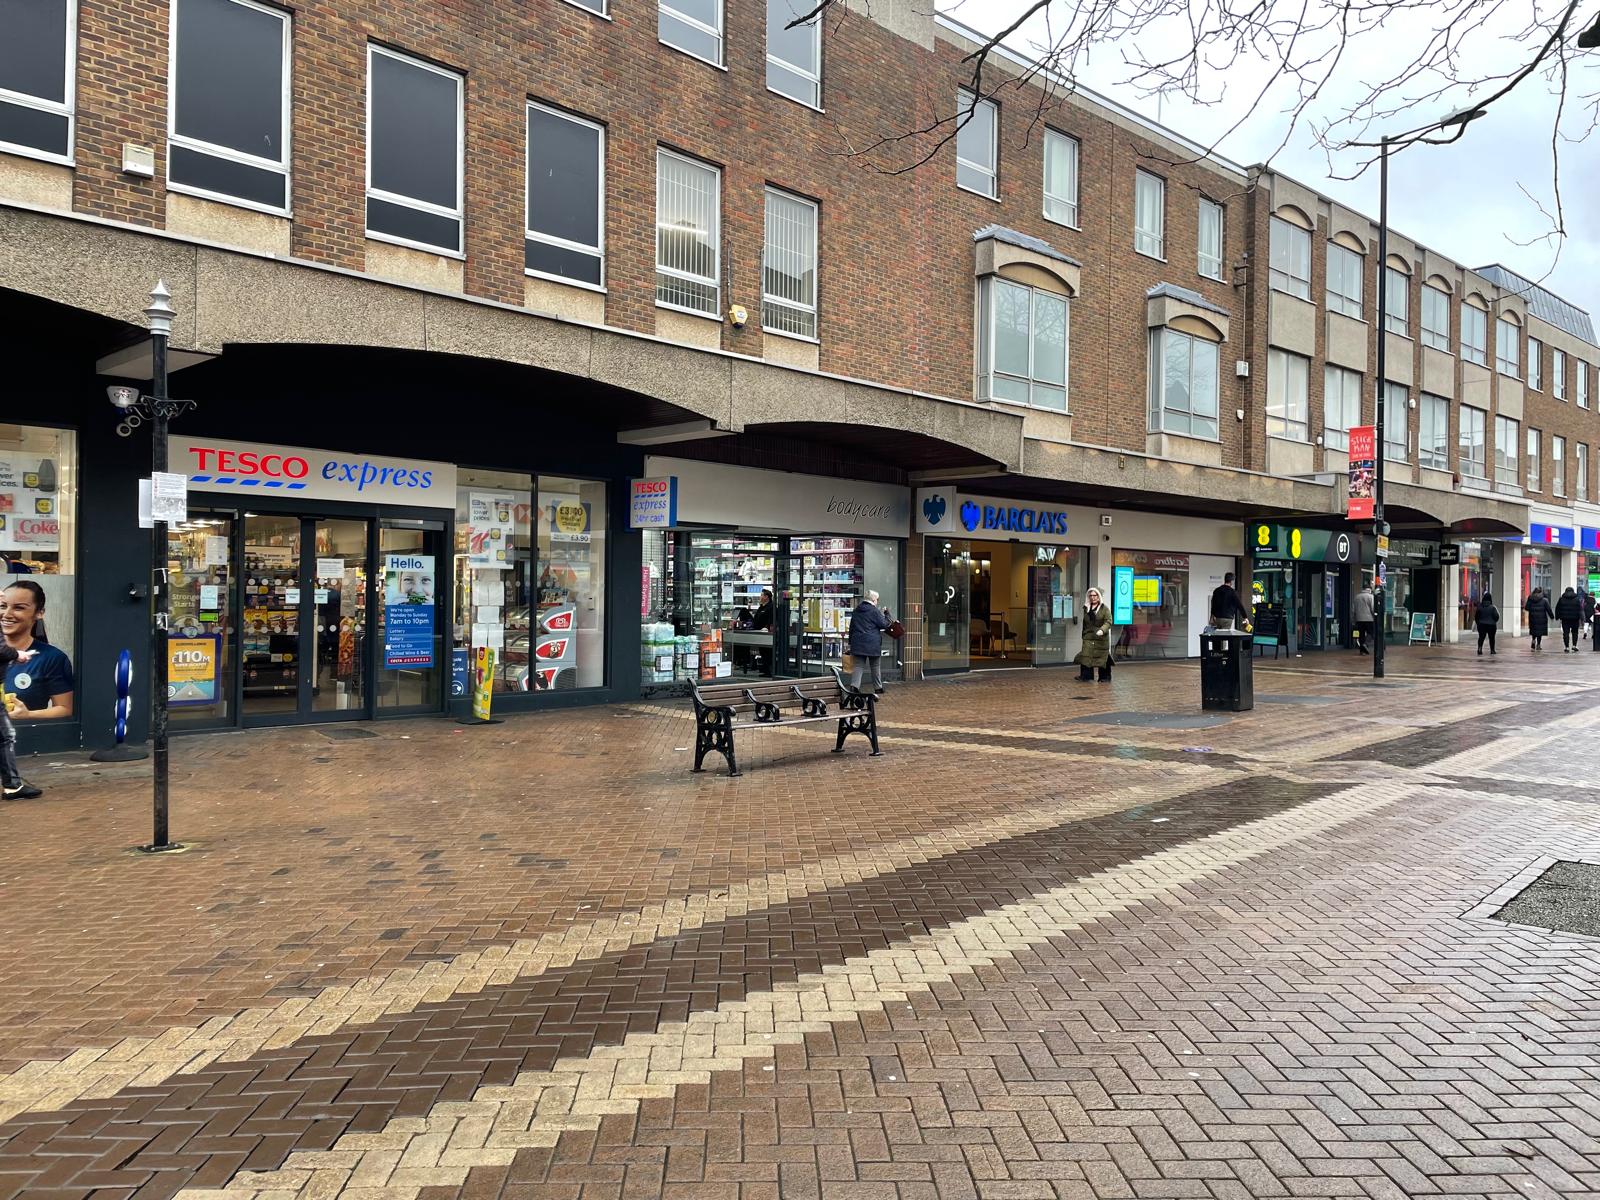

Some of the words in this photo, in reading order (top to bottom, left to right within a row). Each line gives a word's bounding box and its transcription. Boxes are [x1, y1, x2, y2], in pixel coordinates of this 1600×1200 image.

[189, 448, 309, 478] TESCO
[322, 461, 432, 491] express
[633, 481, 667, 493] TESCO
[634, 500, 666, 512] express
[827, 496, 890, 523] bodycare
[983, 505, 1067, 535] BARCLAYS
[20, 520, 58, 534] Coke
[571, 534, 589, 542] £3.90
[1340, 541, 1348, 553] BT
[391, 557, 424, 569] Hello.
[172, 593, 199, 602] Stronge
